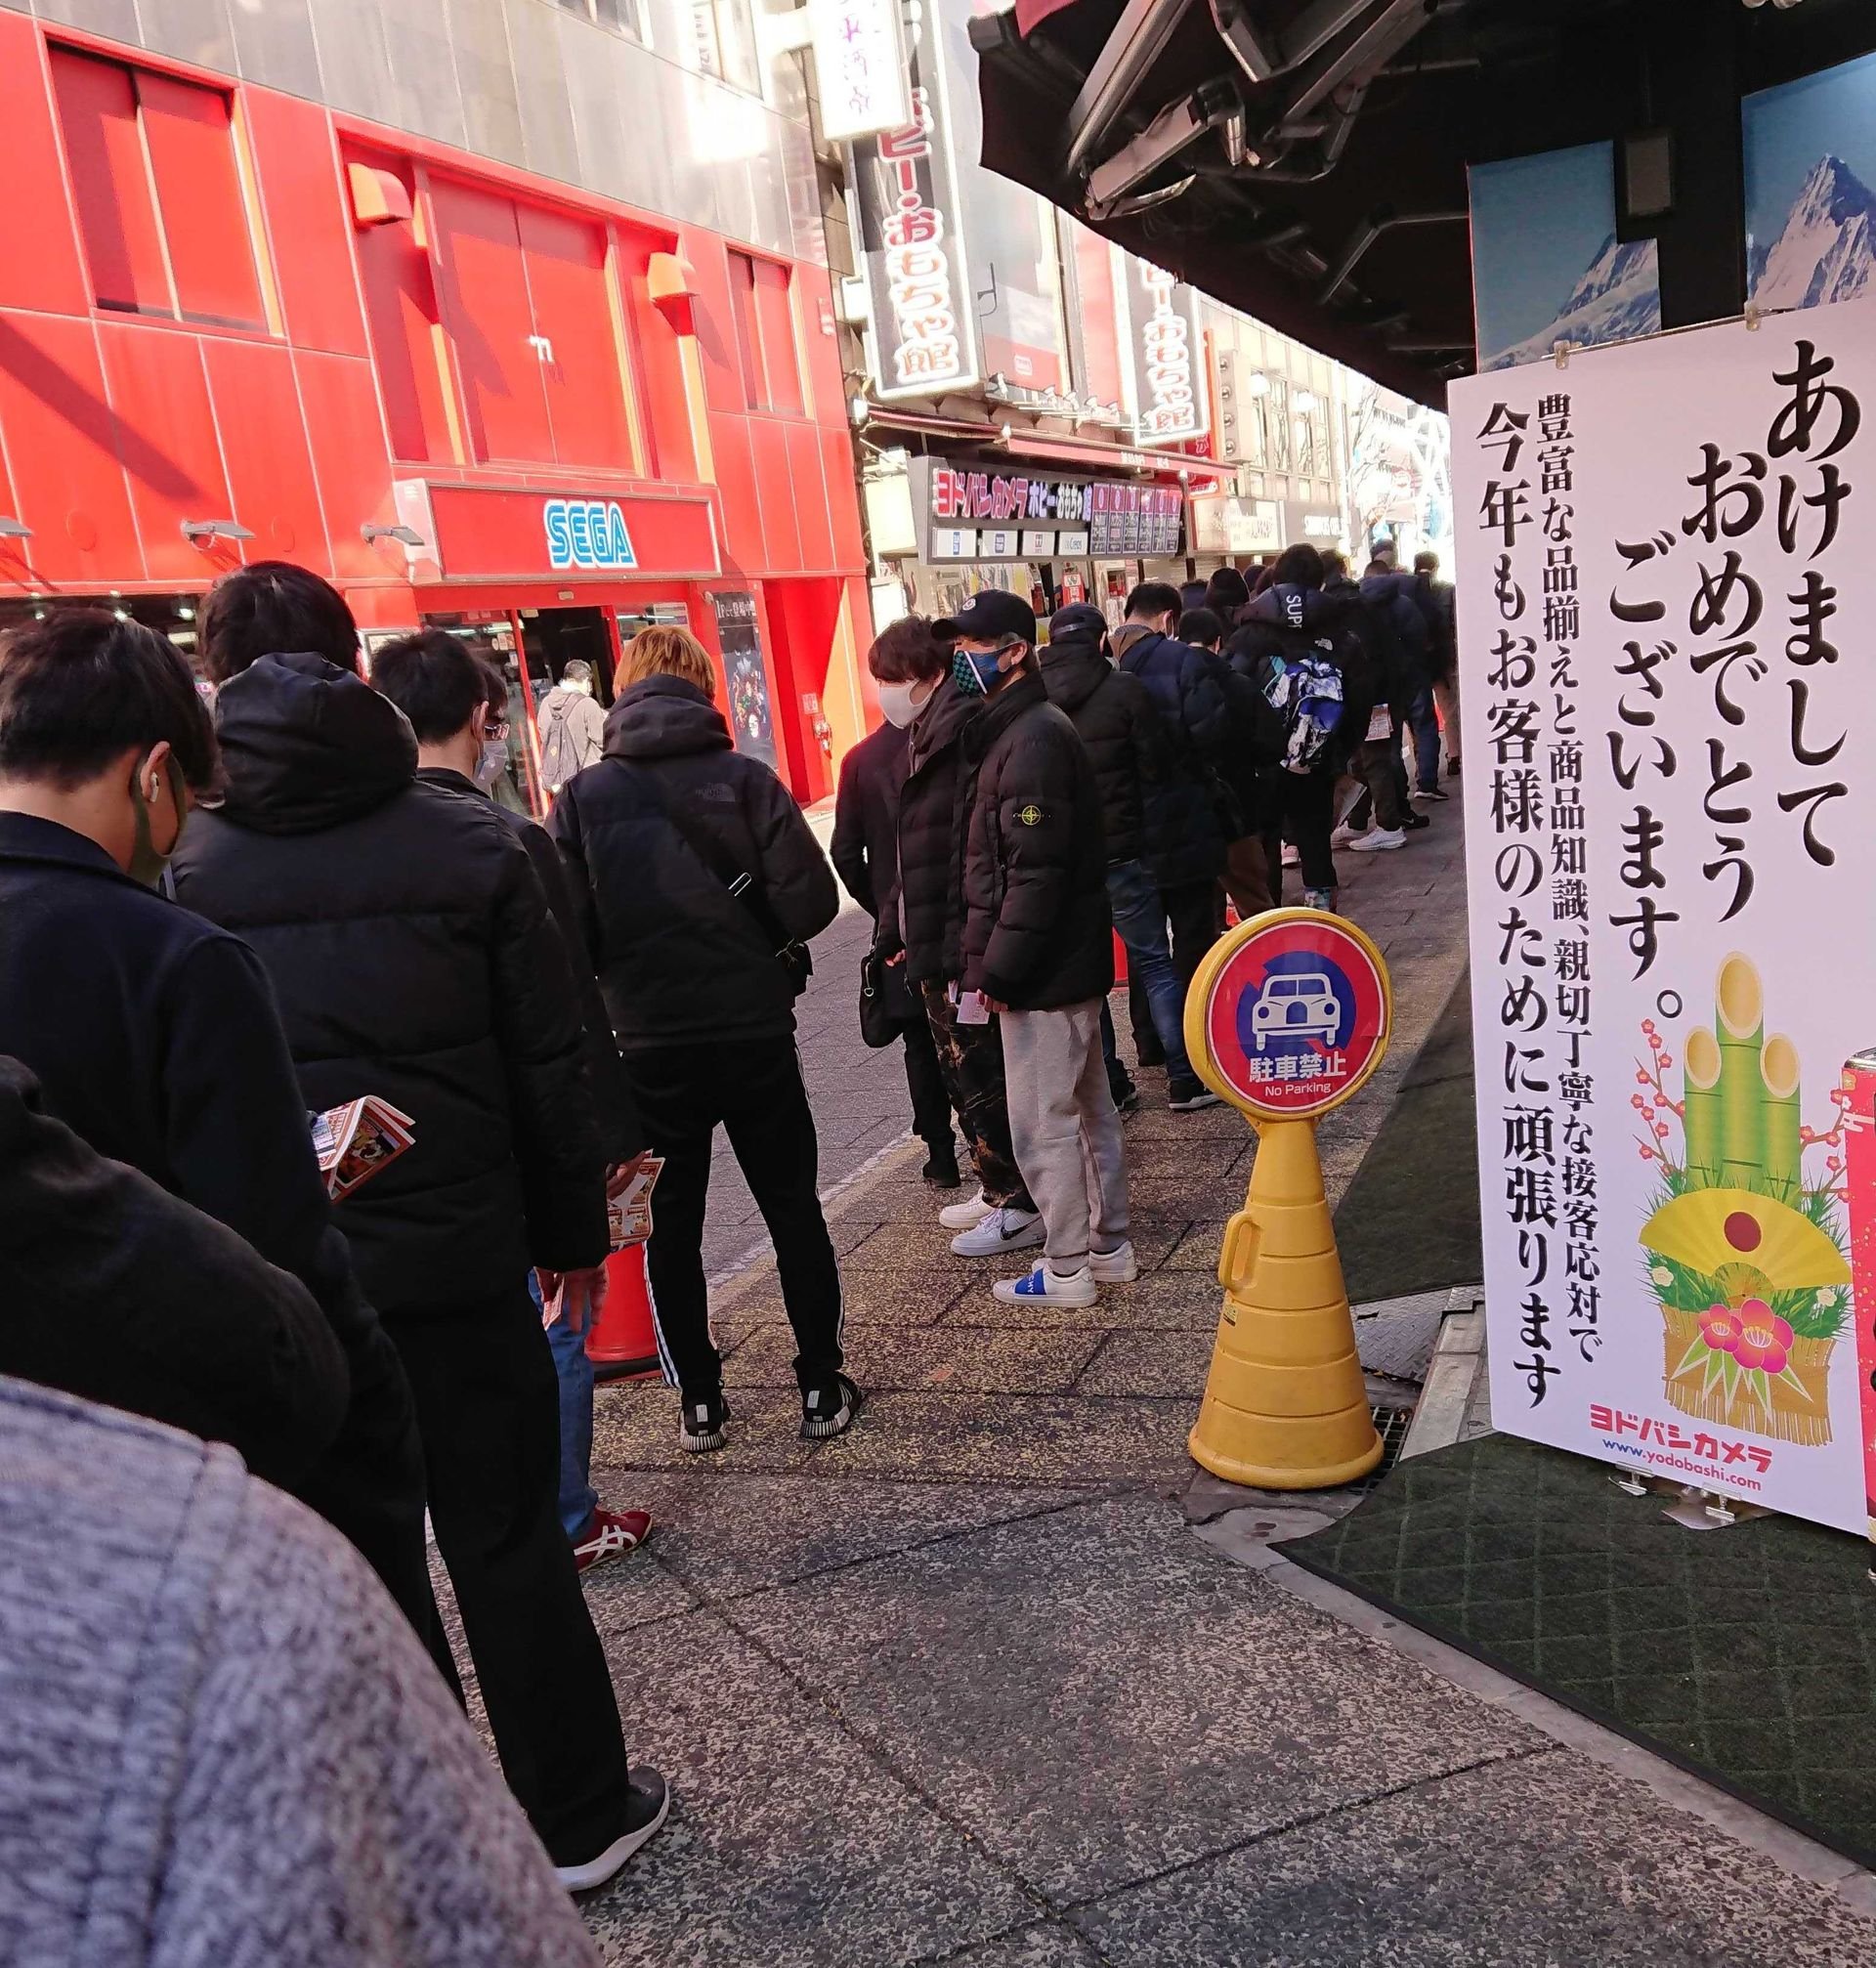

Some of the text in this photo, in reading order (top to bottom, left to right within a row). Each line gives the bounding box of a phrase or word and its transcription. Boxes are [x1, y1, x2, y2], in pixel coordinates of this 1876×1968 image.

[936, 469, 1029, 519] ヨドバシカメラ
[543, 499, 638, 569] SEGA
[1768, 339, 1861, 866] あけまして
[1682, 443, 1769, 922] おめでとう
[1606, 530, 1683, 1018] ございます。
[1476, 402, 1560, 1408] 今年もお客様のために頑張ります
[1537, 393, 1600, 1362] 豊富な品揃えと商品知識、親切丁寧な接客応対で
[1249, 1051, 1346, 1083] 駐車禁止
[1265, 1082, 1332, 1096] No Parking
[1590, 1403, 1772, 1474] ヨドバシカメラ
[1602, 1438, 1762, 1491] www.yodobashi.com
